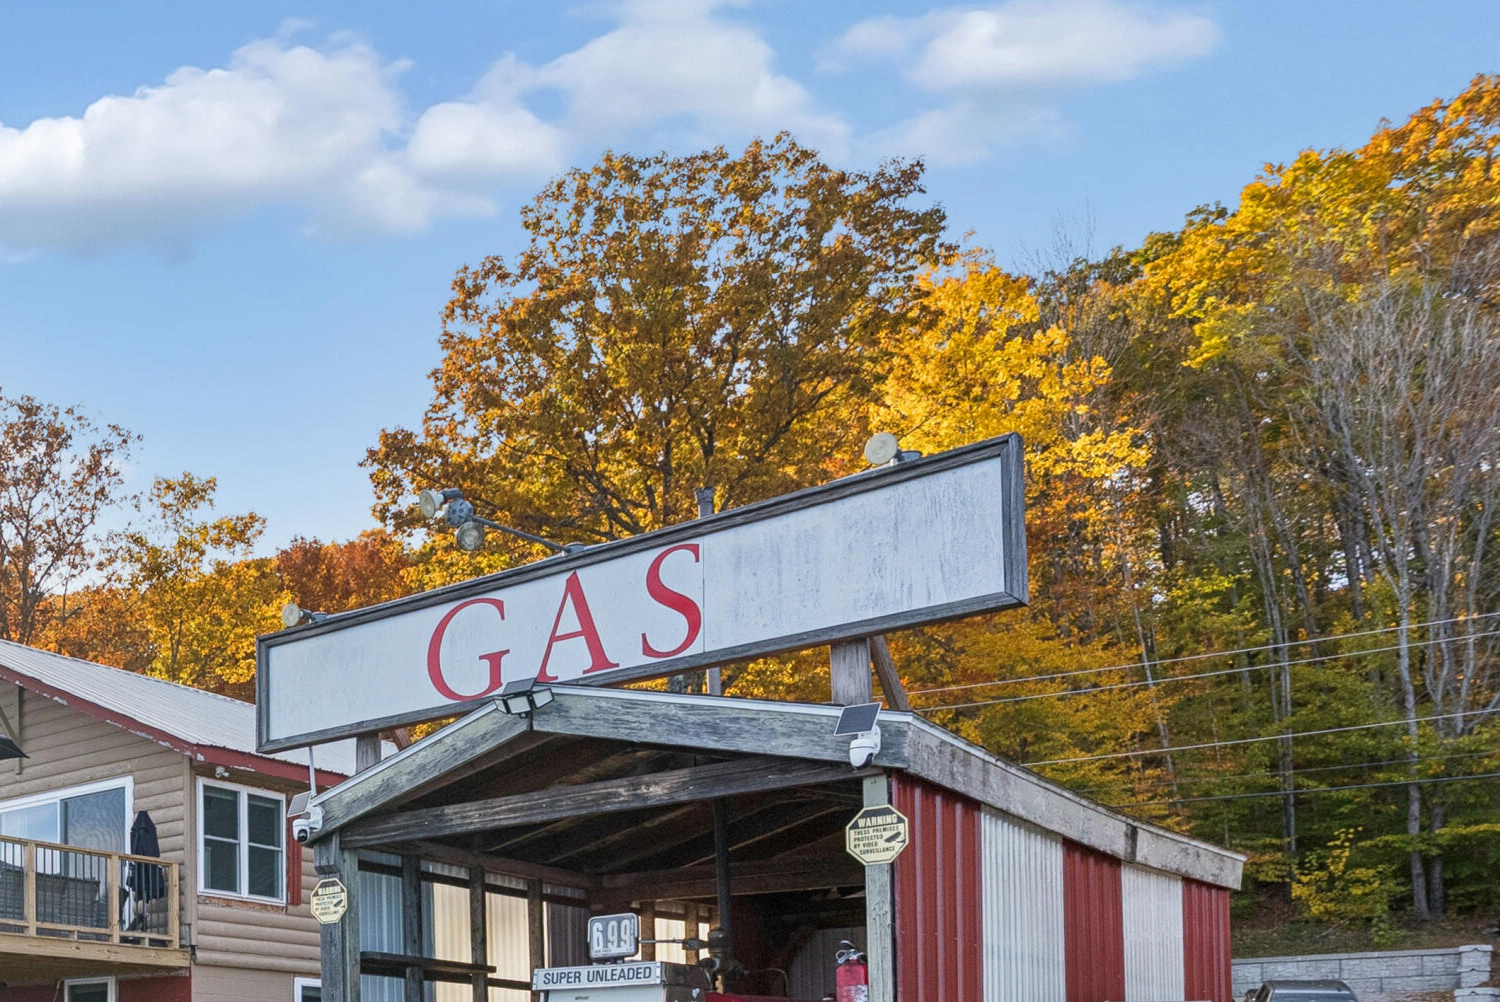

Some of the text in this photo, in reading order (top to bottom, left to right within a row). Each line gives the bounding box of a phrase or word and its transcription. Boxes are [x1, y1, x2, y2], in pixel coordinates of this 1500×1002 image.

[427, 543, 702, 701] GAS
[858, 814, 897, 827] WARNING
[872, 825, 899, 833] PREMISES
[854, 834, 883, 842] PROTECTED
[860, 846, 895, 855] SURVEILLANCE
[543, 966, 652, 985] SUPER UNLEADED
